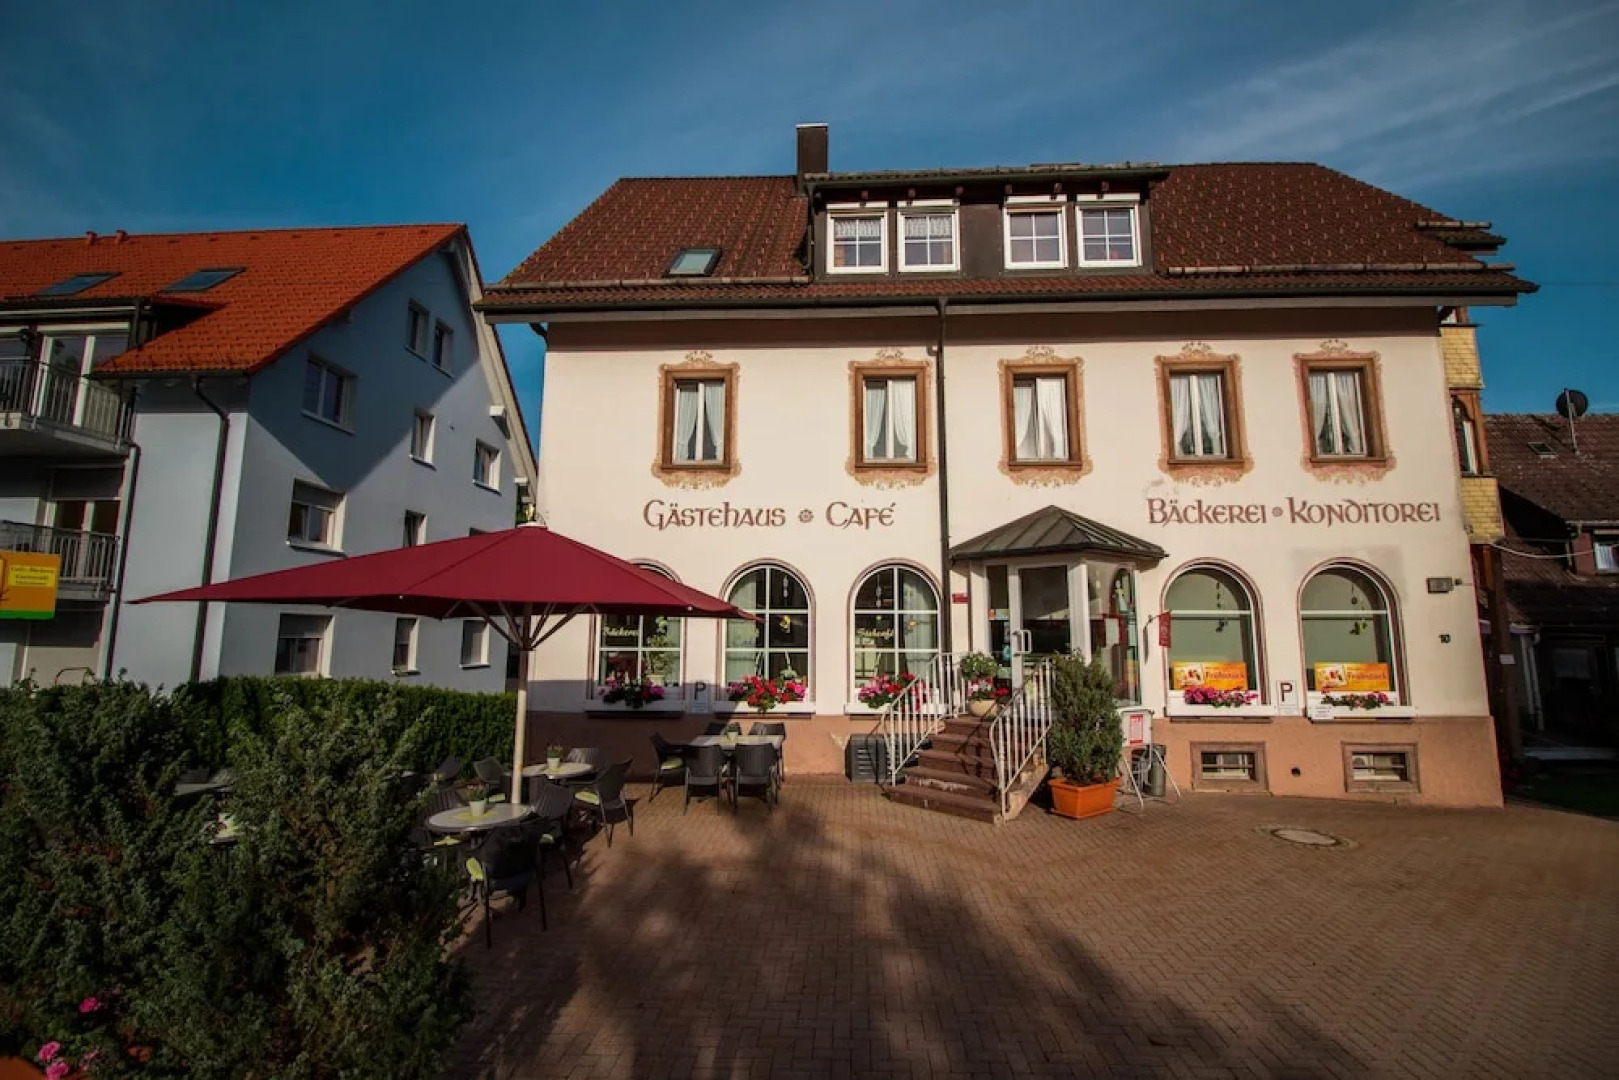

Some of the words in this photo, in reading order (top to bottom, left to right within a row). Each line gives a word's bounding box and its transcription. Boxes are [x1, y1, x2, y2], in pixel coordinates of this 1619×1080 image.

[643, 499, 786, 531] Gästehaus
[826, 501, 896, 531] Café
[1147, 498, 1266, 527] Bäckerei
[1286, 497, 1441, 527] Konditorei
[694, 681, 706, 700] P
[1280, 682, 1293, 702] P
